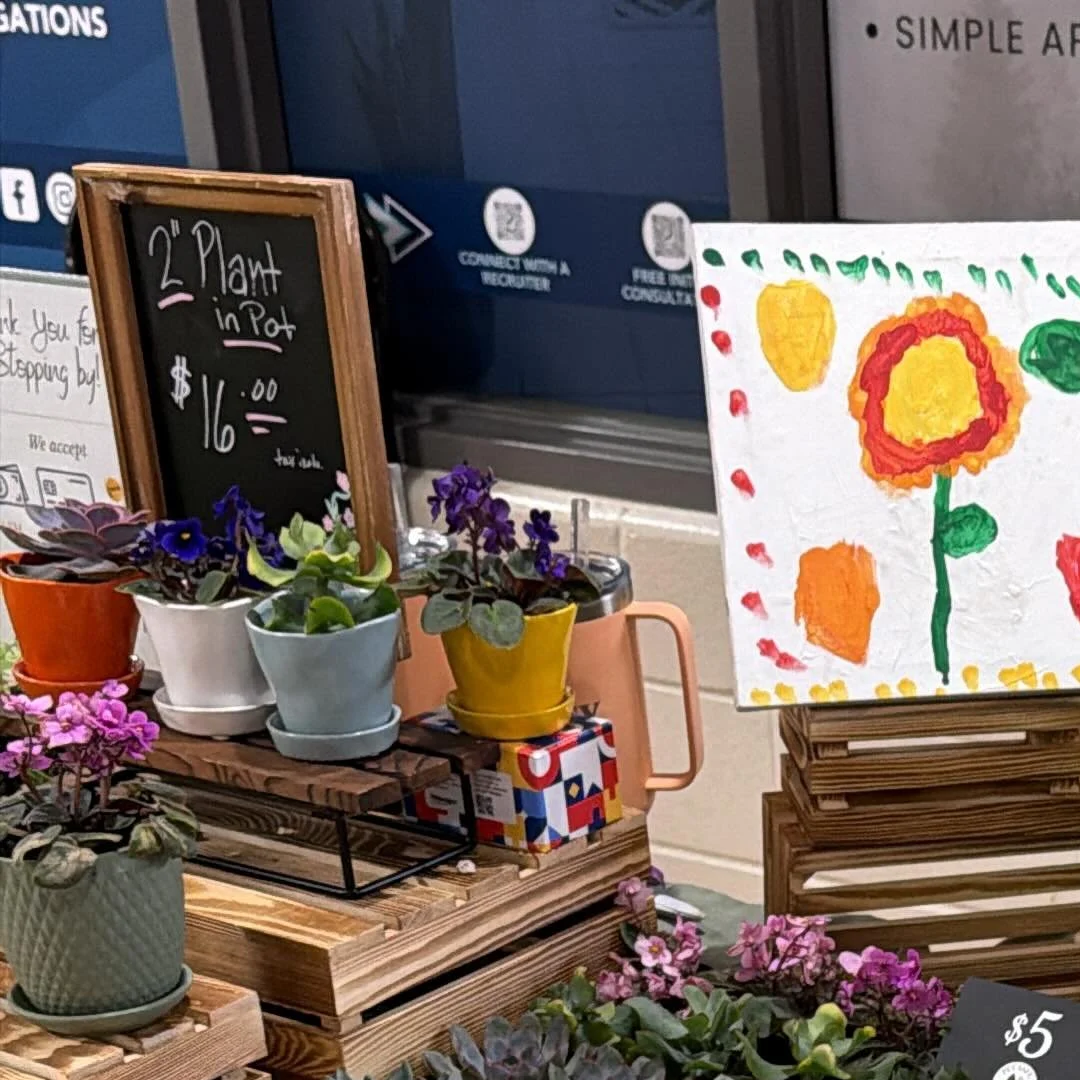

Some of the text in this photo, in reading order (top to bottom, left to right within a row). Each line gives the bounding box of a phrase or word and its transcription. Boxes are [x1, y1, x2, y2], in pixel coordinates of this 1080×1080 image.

[895, 15, 1024, 55] SIMPLE
[192, 220, 282, 296] Plant
[458, 250, 571, 277] CONNECT WITH A
[631, 266, 667, 286] FREE
[480, 271, 551, 292] RECRUITER
[30, 308, 70, 354] You
[212, 297, 296, 341] in Pot
[75, 346, 102, 405] by!
[28, 433, 88, 461] We accept
[1004, 1010, 1063, 1059] $5
